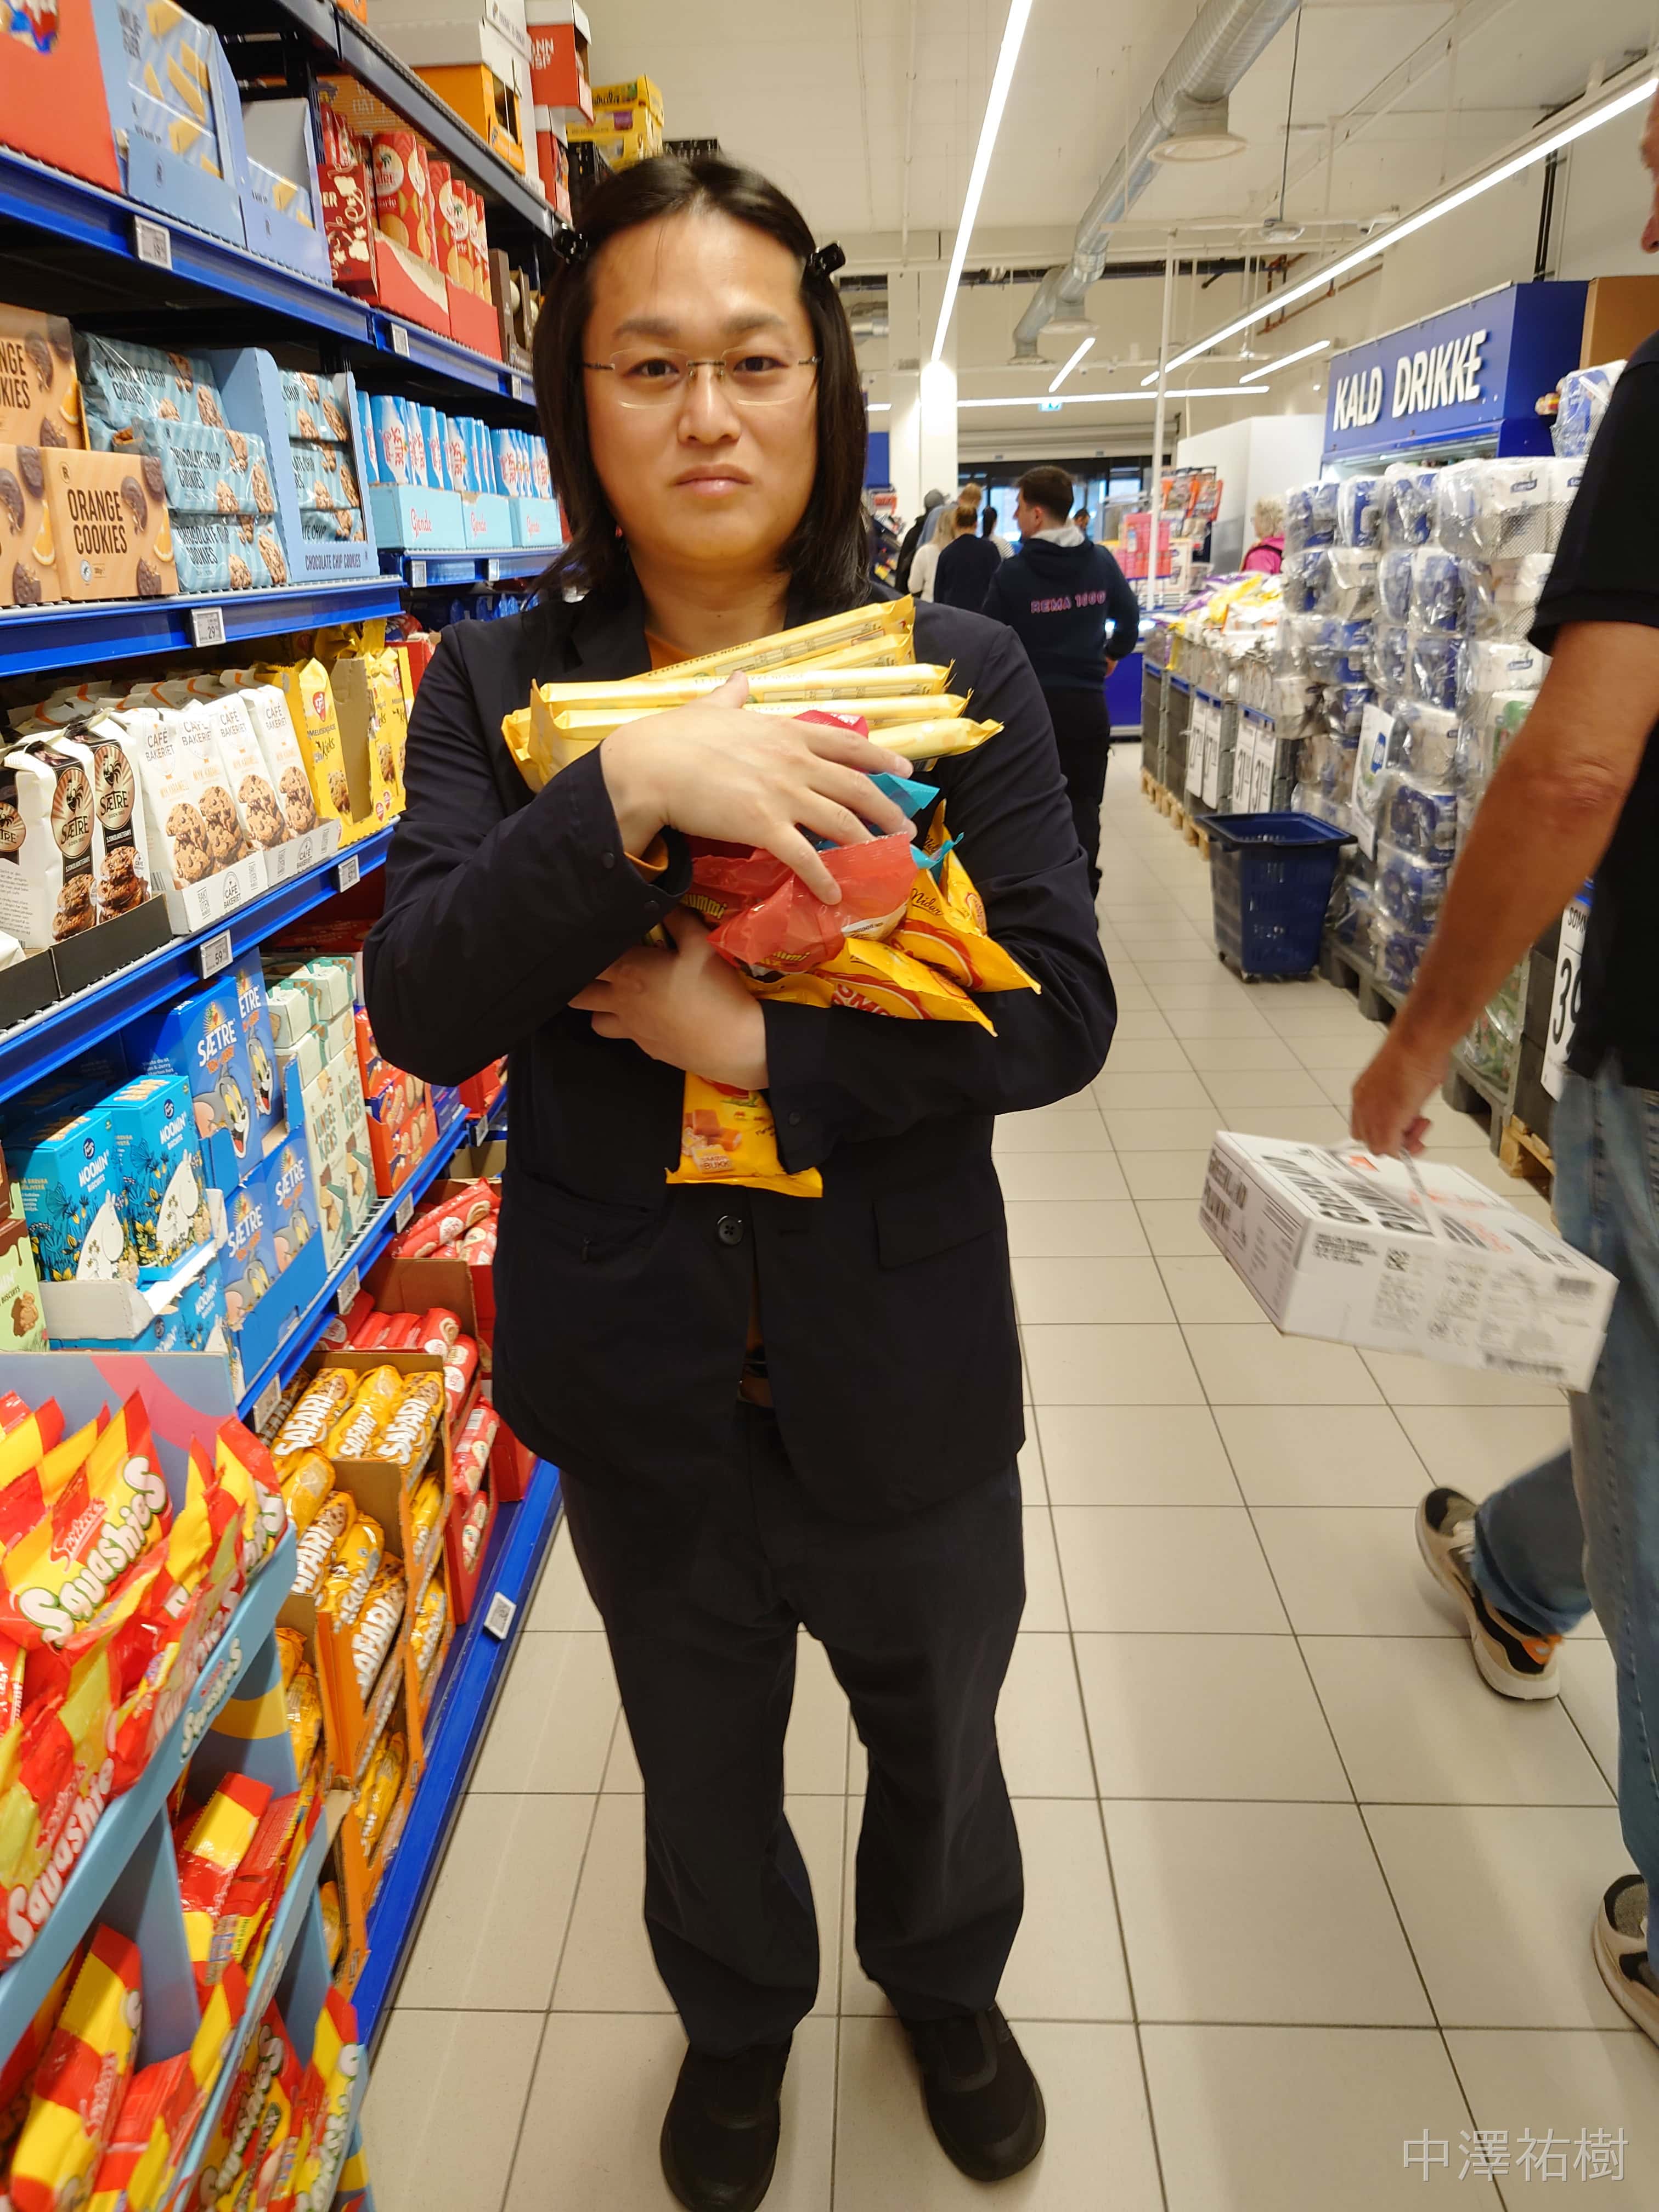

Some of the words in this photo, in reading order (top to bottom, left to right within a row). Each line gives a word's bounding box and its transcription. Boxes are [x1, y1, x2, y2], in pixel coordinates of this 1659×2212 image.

[0, 341, 26, 376] NGE
[0, 379, 31, 409] KIES
[1333, 366, 1384, 432] KALD
[1392, 329, 1487, 418] DRIKKE
[67, 488, 124, 522] ORANGE
[74, 524, 128, 555] COOKIES
[305, 554, 331, 571] CHOCOLATE
[332, 553, 343, 569] CHIP
[343, 554, 361, 569] COOKIES
[1031, 596, 1071, 613] REMA
[1075, 591, 1106, 608] 1000
[147, 727, 168, 748] CAFÉ
[182, 730, 212, 747] BAKERIE
[221, 723, 246, 738] BAKERIET
[145, 744, 175, 762] BAKERIET
[100, 790, 129, 816] SÆTRE
[61, 815, 89, 845] SÆTRE
[911, 887, 944, 917] Nidar
[215, 951, 223, 966] 59
[198, 1020, 238, 1068] SÆTRE
[160, 1113, 187, 1145] MOOMIN
[78, 1154, 109, 1188] MOOMIN
[703, 1161, 729, 1170] BUKK
[87, 1173, 105, 1193] BISCUITS
[275, 1159, 306, 1206] SÆTRE
[228, 1205, 264, 1258] SÆTRE
[274, 1393, 335, 1456] SAFARI
[338, 1411, 379, 1459] SAFARI
[376, 1397, 431, 1465] SAFARI
